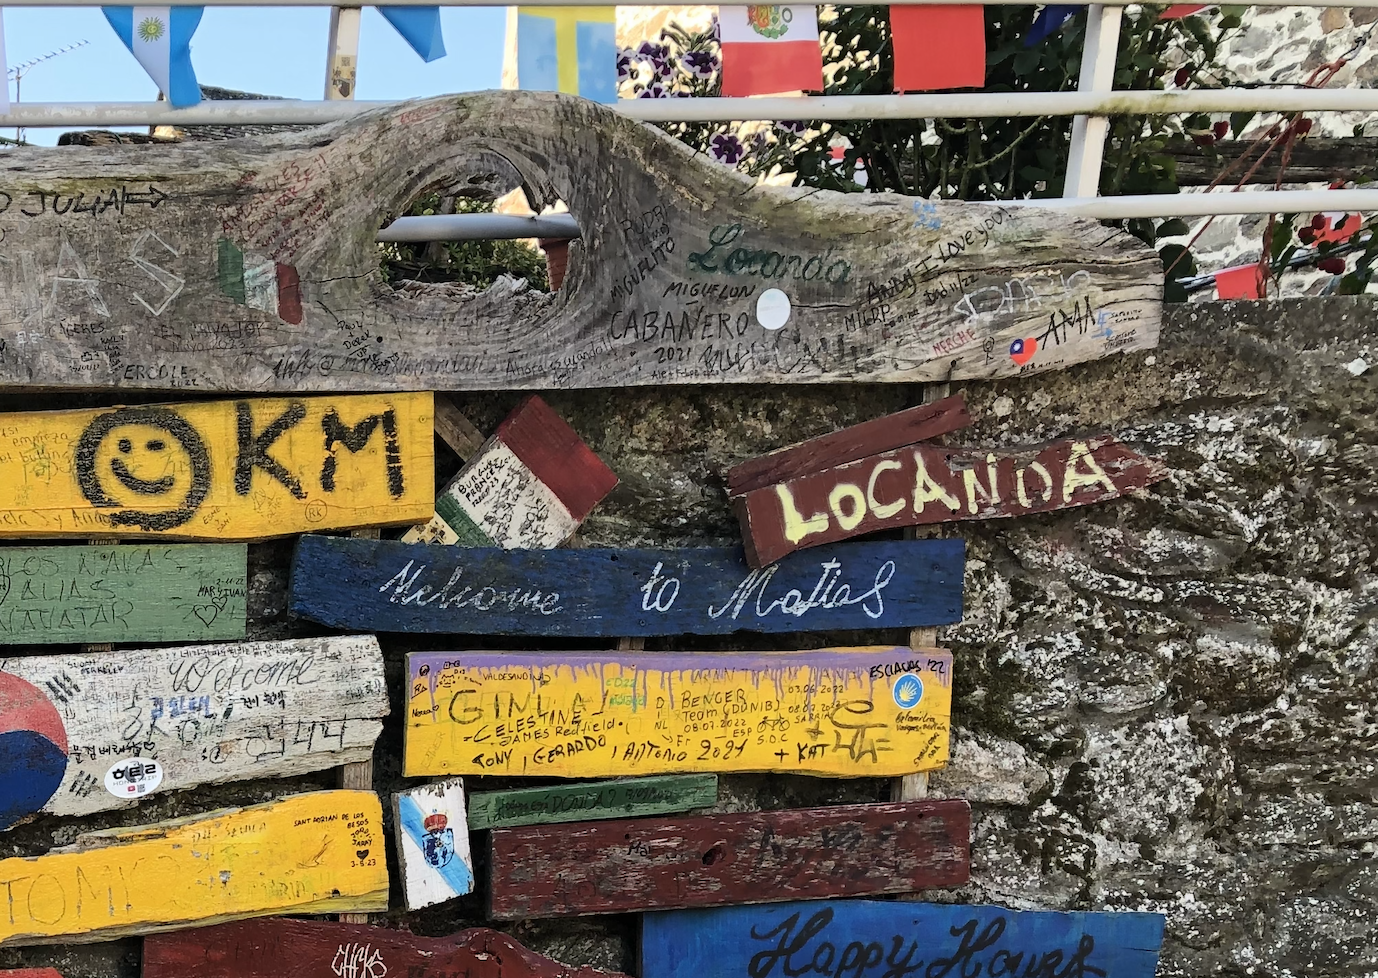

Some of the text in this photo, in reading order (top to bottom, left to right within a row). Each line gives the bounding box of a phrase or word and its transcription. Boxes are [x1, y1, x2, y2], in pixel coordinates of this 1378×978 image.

[234, 400, 408, 501] KM
[774, 441, 1120, 545] LOCANDA
[638, 560, 680, 612] to
